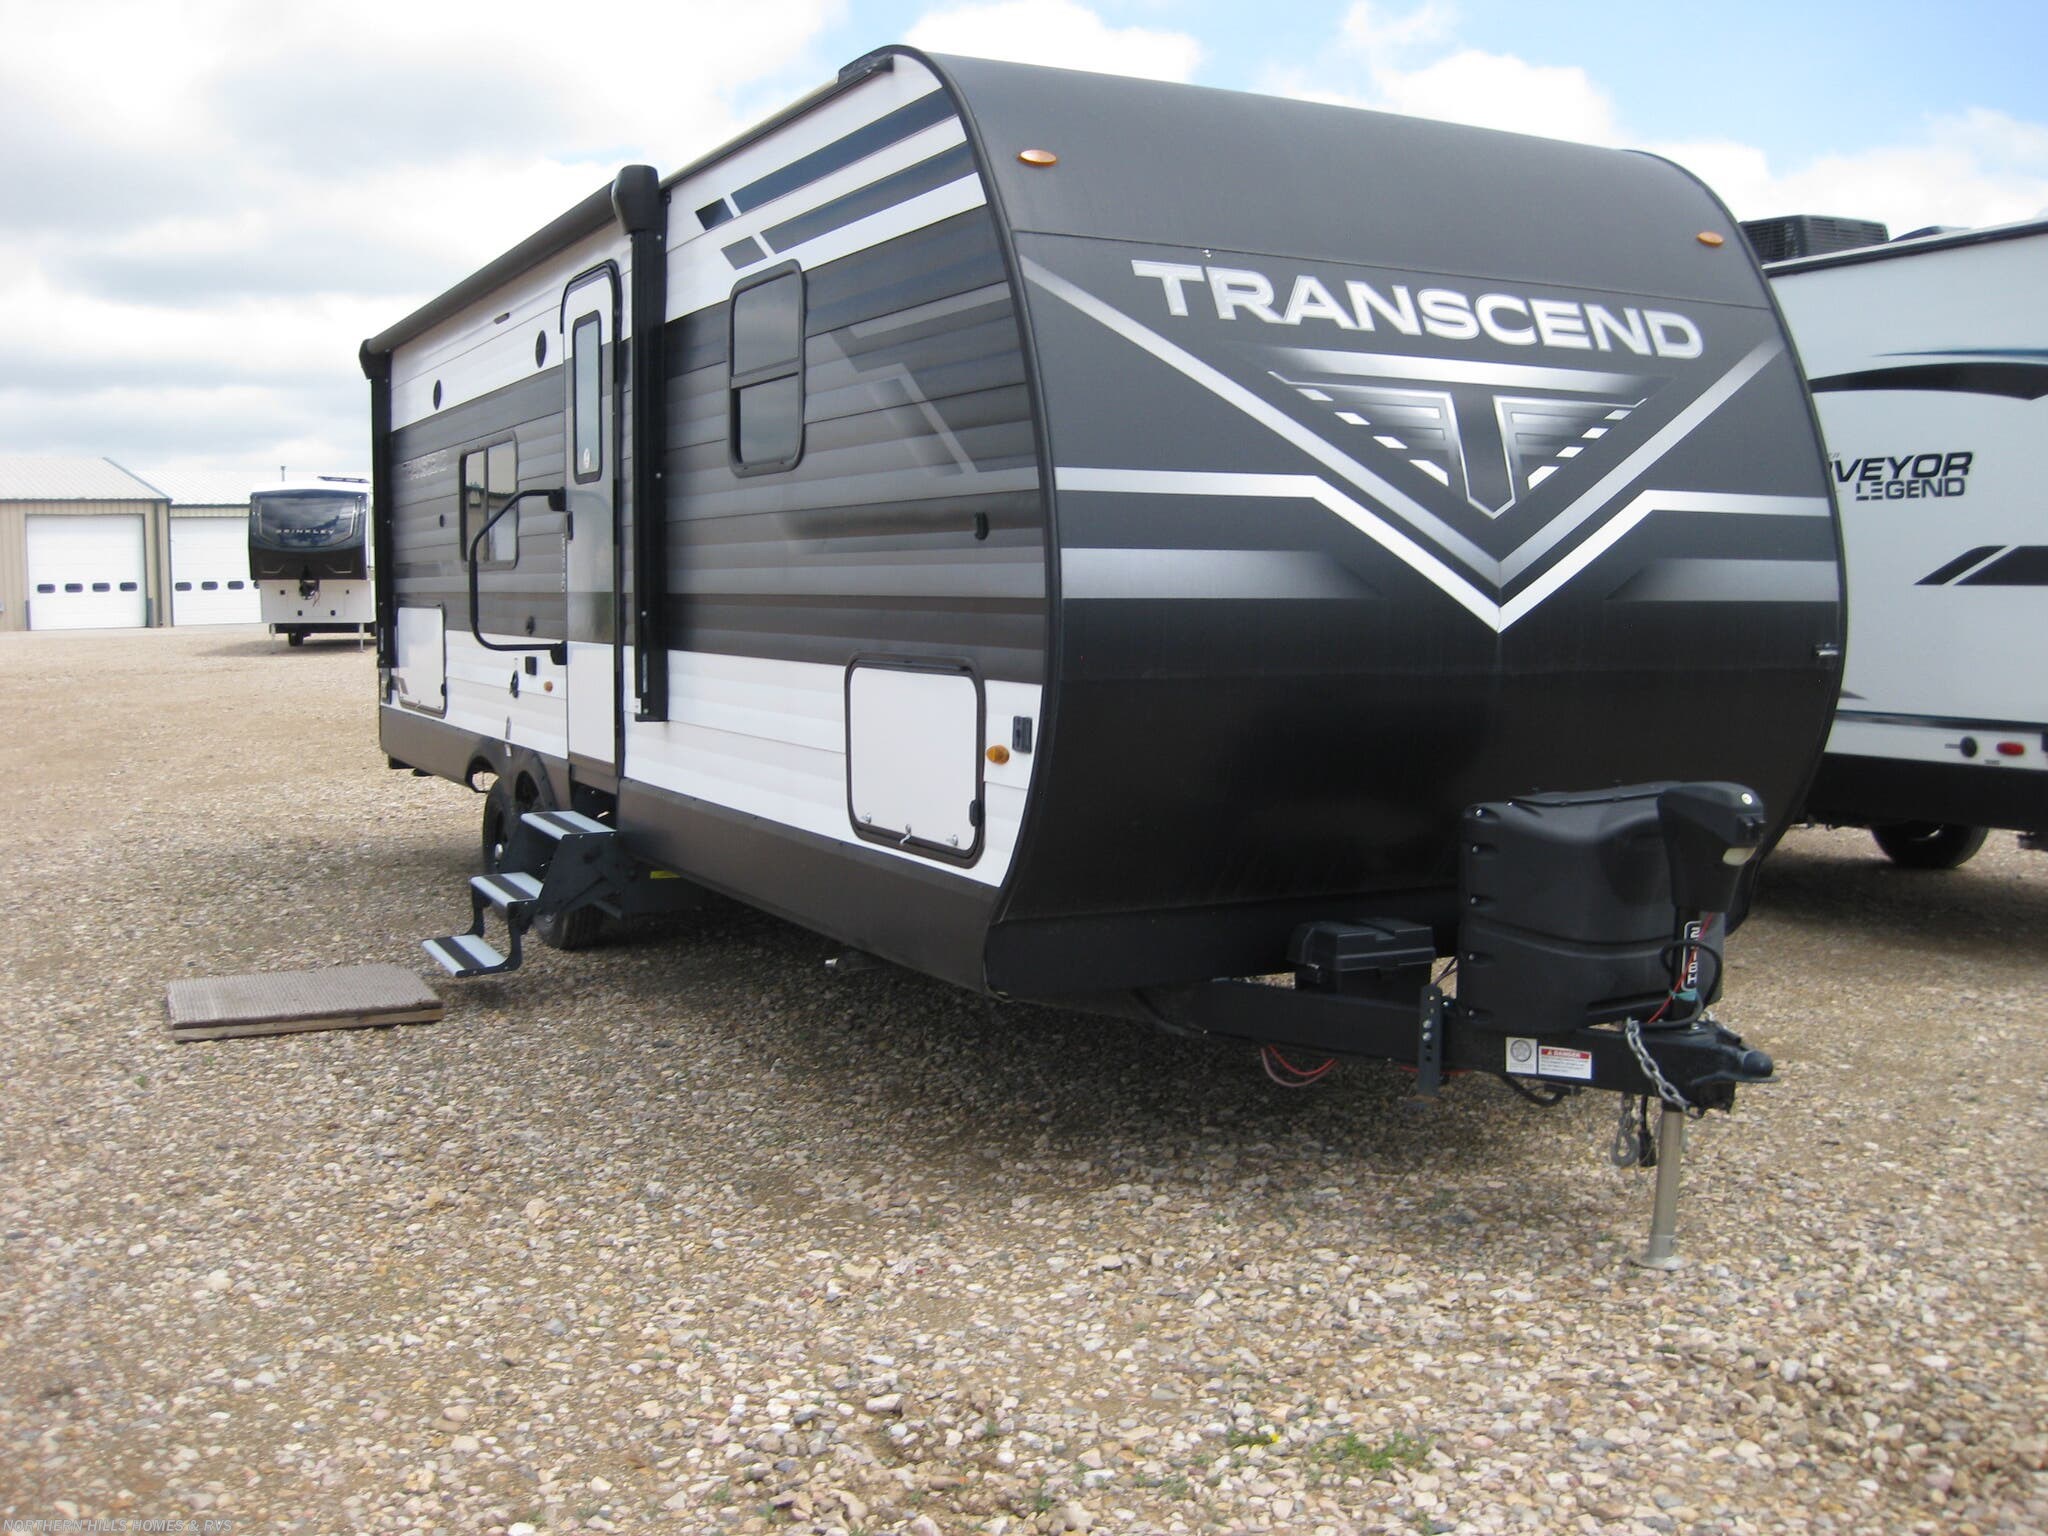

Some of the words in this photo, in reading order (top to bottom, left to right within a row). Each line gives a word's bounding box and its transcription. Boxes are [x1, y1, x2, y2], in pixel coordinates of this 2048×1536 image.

[1131, 259, 1704, 360] TRANSCEND
[1829, 451, 1974, 483] VEYOR
[1855, 477, 1966, 502] LEGEND
